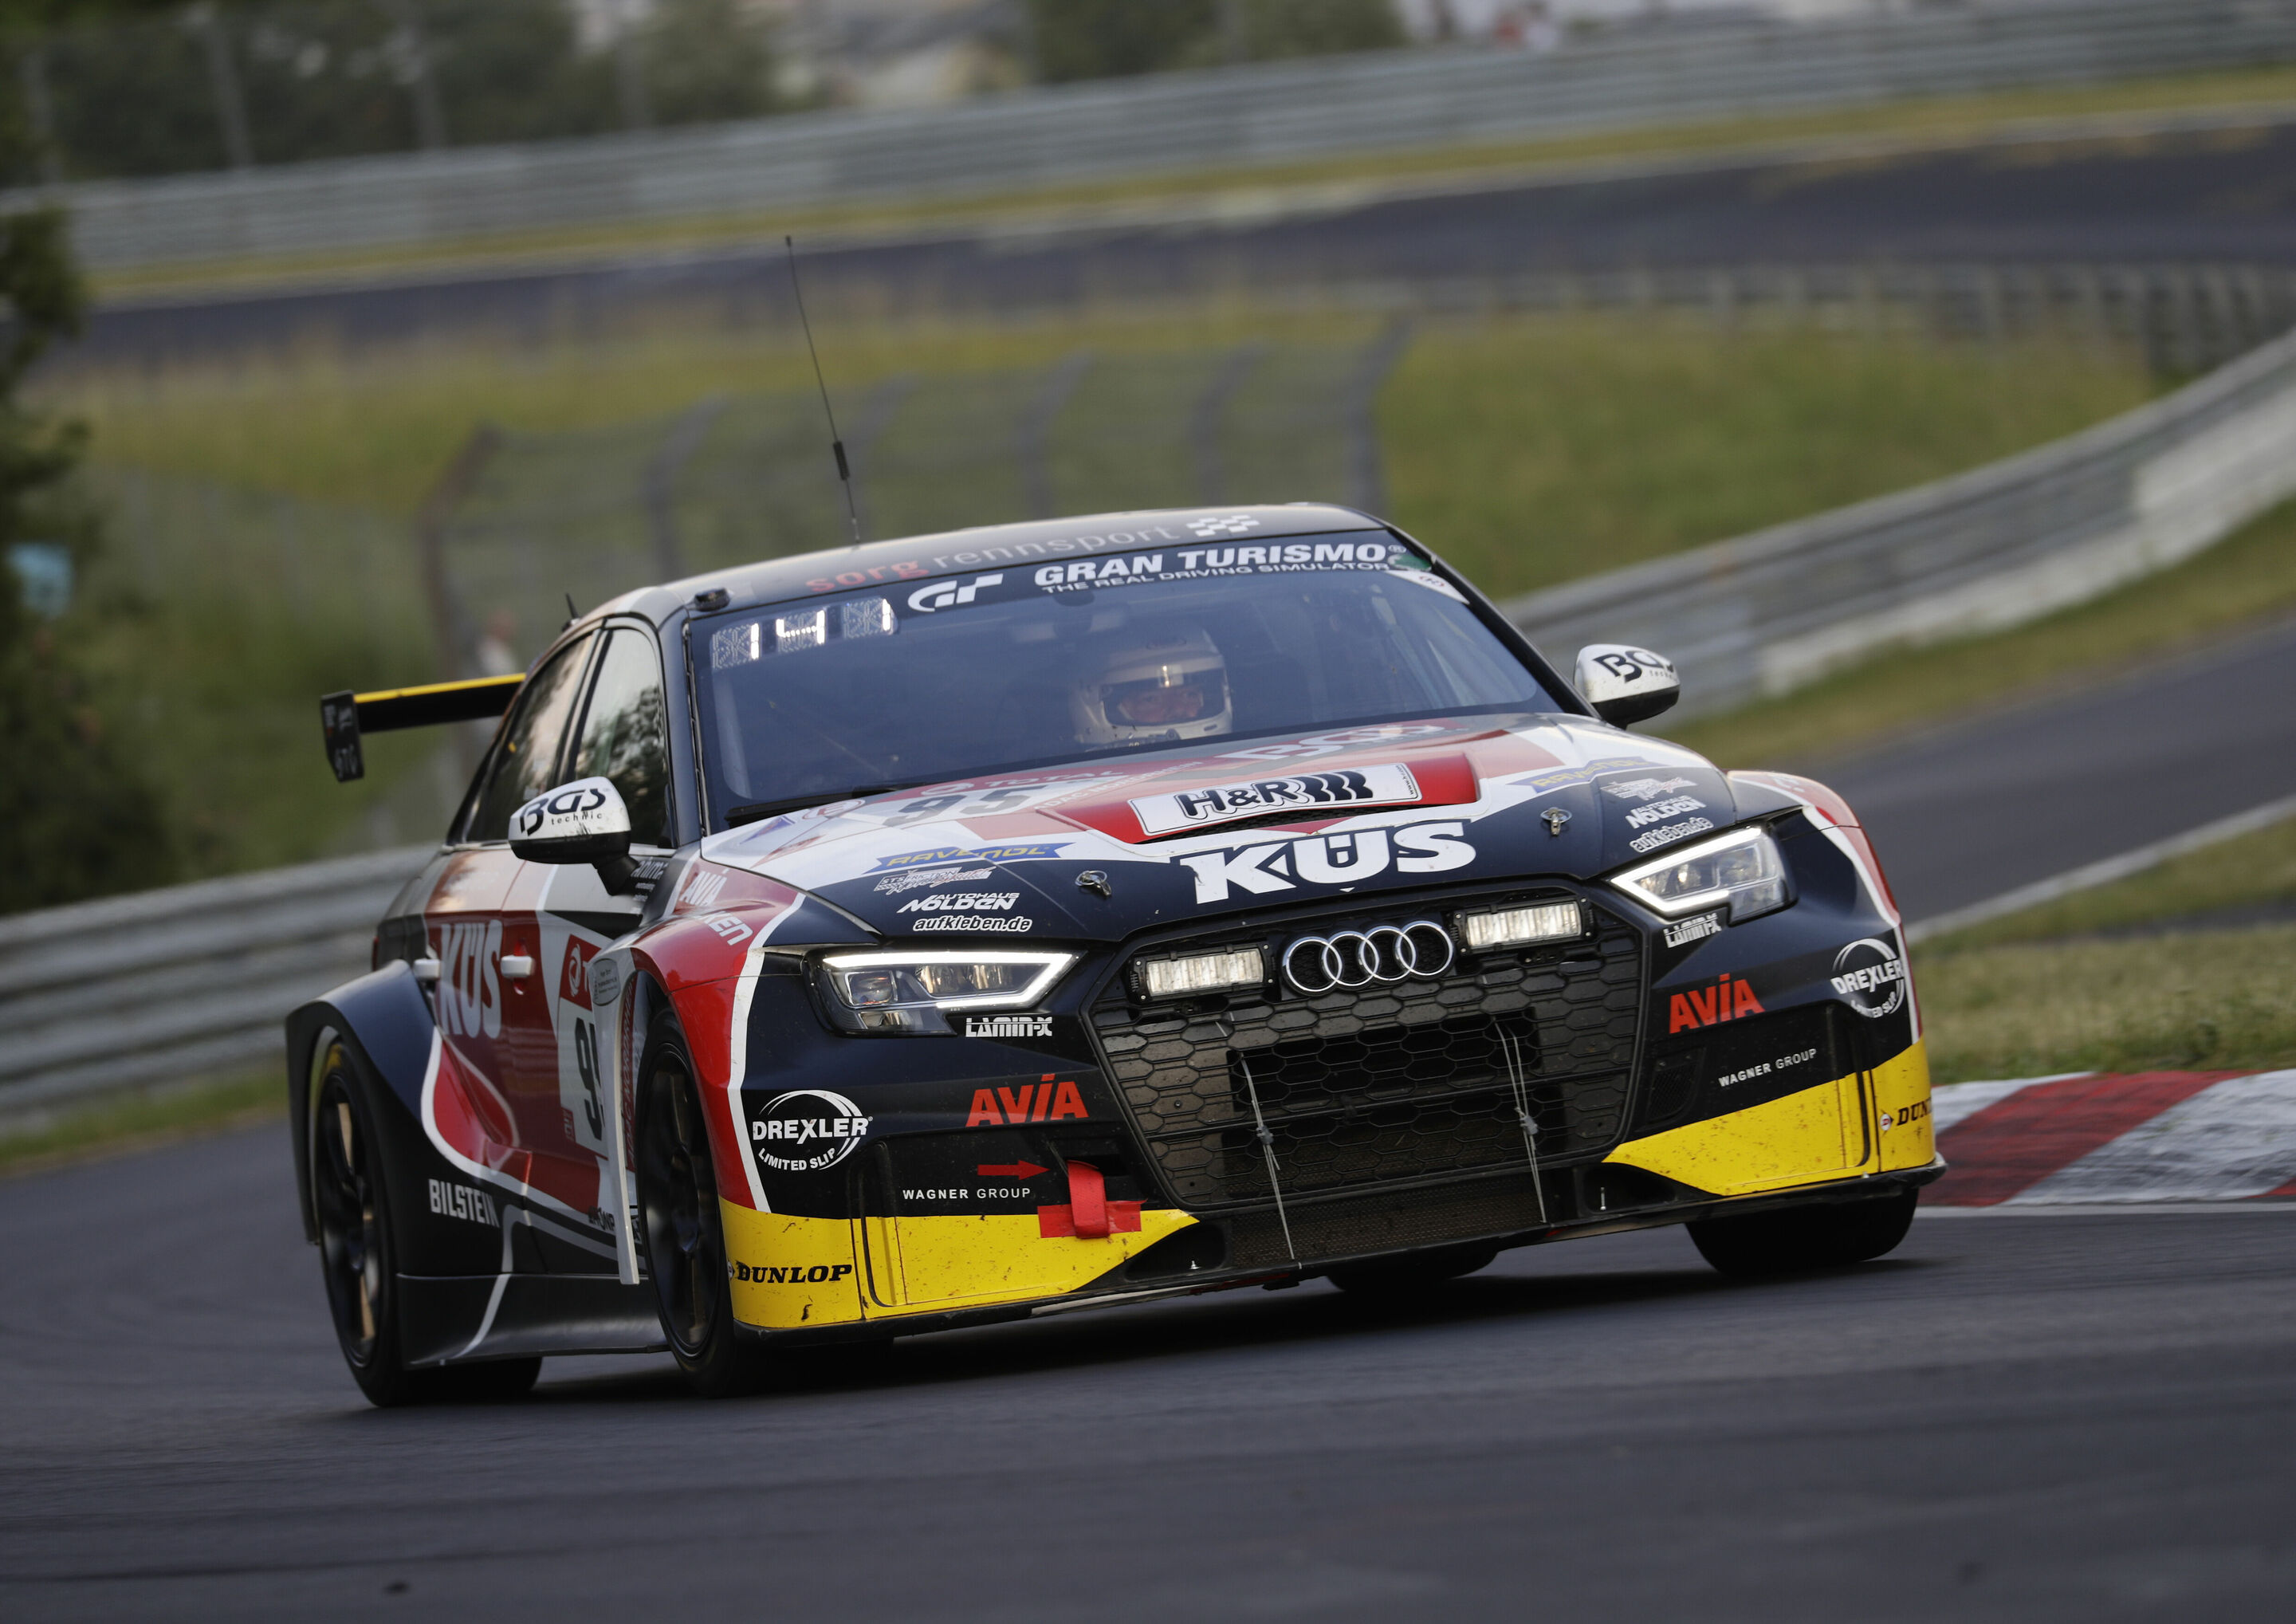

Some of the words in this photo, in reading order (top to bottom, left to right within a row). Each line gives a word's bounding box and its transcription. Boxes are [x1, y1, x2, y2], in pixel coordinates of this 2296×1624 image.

[805, 560, 930, 592] sorg
[933, 525, 1181, 568] rennsport
[1034, 553, 1163, 587] GRAN
[1041, 582, 1089, 594] THE
[1094, 573, 1155, 588] REAL
[1158, 565, 1253, 581] DRIVING
[1257, 561, 1390, 573] SIMULATOR
[519, 787, 607, 836] BGS
[883, 784, 1047, 828] 95
[1174, 777, 1307, 817] H&R
[551, 810, 603, 826] technic
[886, 845, 1049, 867] RAVENOL
[912, 914, 1033, 933] aufkleben.de
[1830, 959, 1905, 995] DREXLER
[1718, 1063, 1771, 1087] WAGNER
[1775, 1048, 1817, 1072] GROUP
[752, 1117, 870, 1145] DREXLER
[757, 1147, 808, 1171] LIMITED
[809, 1147, 836, 1170] SLIP
[428, 1178, 500, 1229] BILSTEIN
[902, 1189, 969, 1201] WAGNER
[977, 1187, 1032, 1200] GROUP
[736, 1262, 853, 1284] DUNLOP
